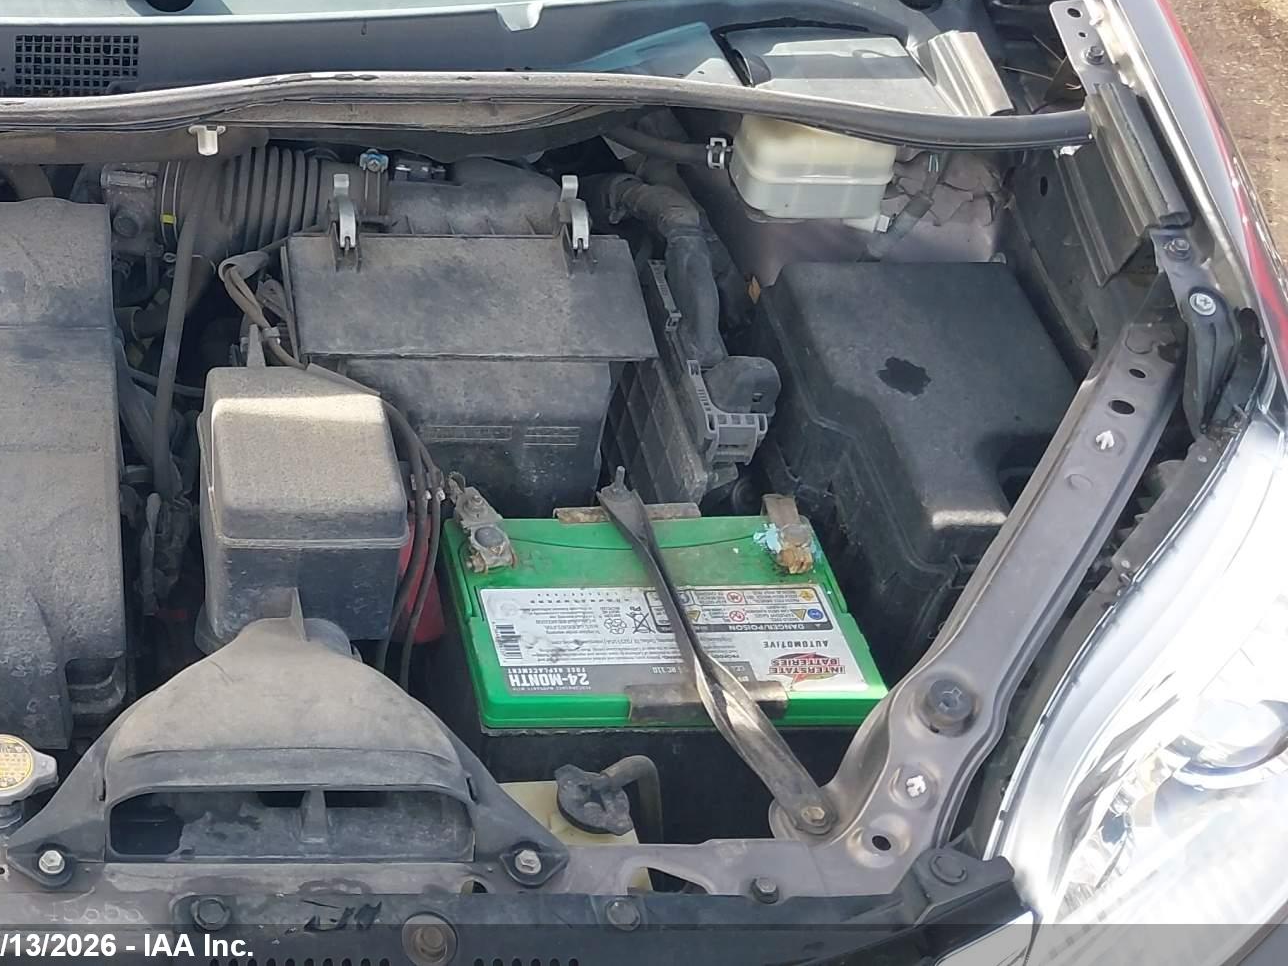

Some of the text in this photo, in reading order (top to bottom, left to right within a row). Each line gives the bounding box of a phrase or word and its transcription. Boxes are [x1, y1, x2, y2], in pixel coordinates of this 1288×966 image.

[763, 640, 829, 649] AUTOMOTIVE
[770, 657, 839, 666] BATTERIES
[769, 666, 846, 675] INTERSTATE
[508, 672, 590, 687] 24-MONTH
